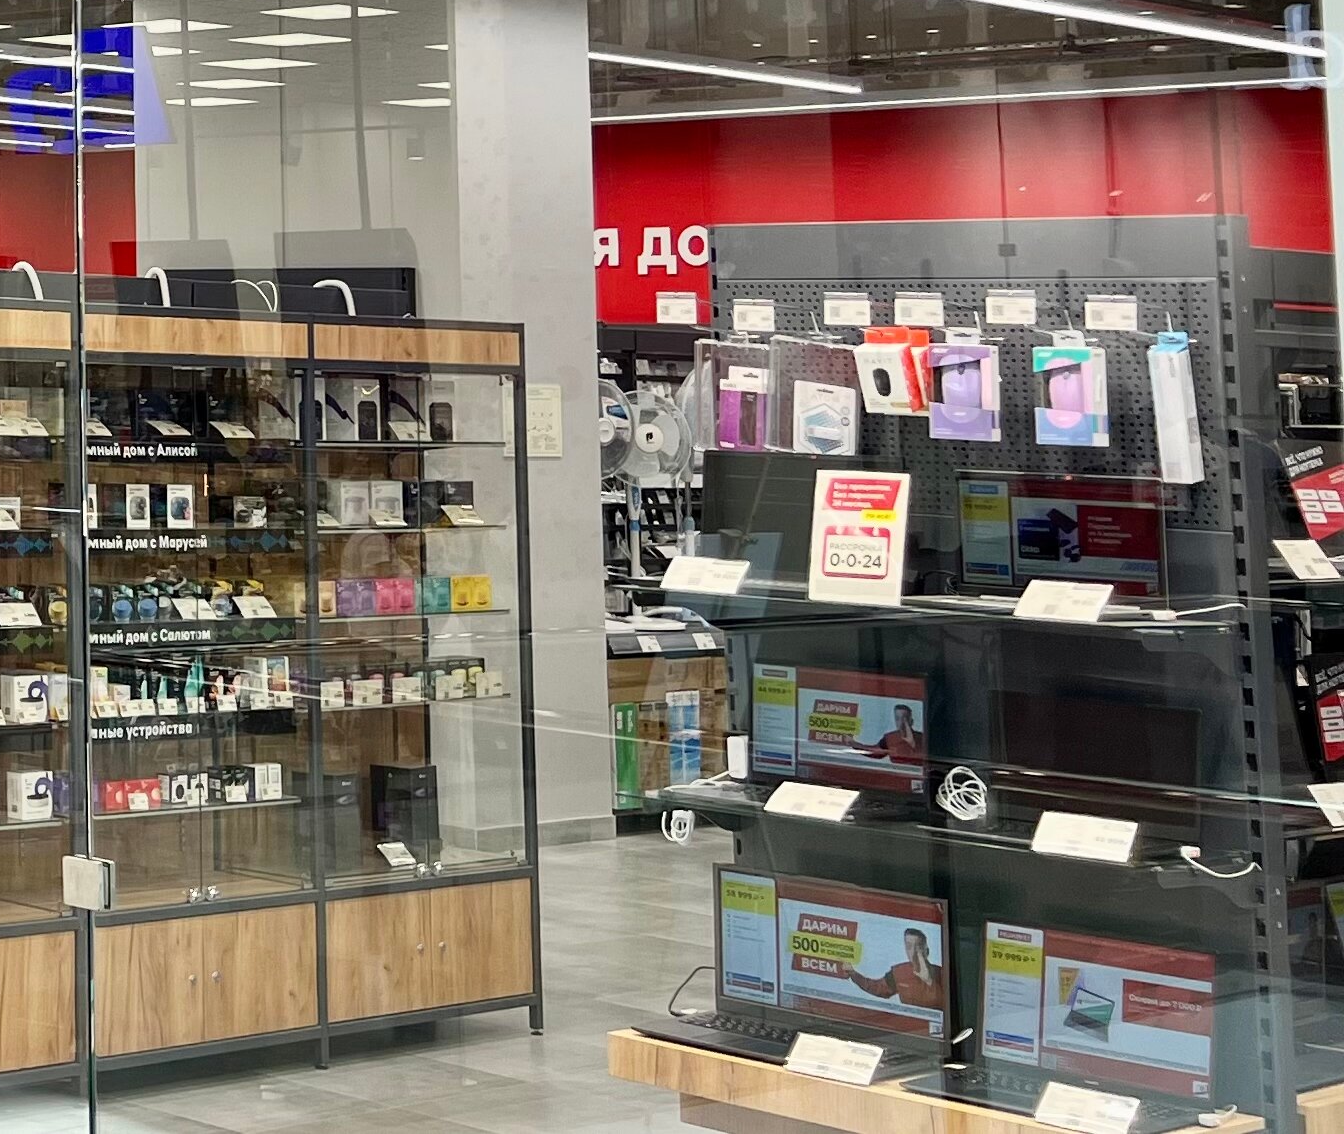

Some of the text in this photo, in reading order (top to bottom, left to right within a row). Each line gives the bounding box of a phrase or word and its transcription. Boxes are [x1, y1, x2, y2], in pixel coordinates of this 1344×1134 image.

[86, 442, 198, 459] мный дом с Алисой
[87, 535, 208, 551] мный дом с Марусей
[89, 629, 211, 645] мный дом с Салютом
[126, 721, 192, 740] устройства
[802, 918, 848, 936] ДАРИМ
[792, 935, 820, 953] 500
[801, 957, 838, 974] ВСЕМ
